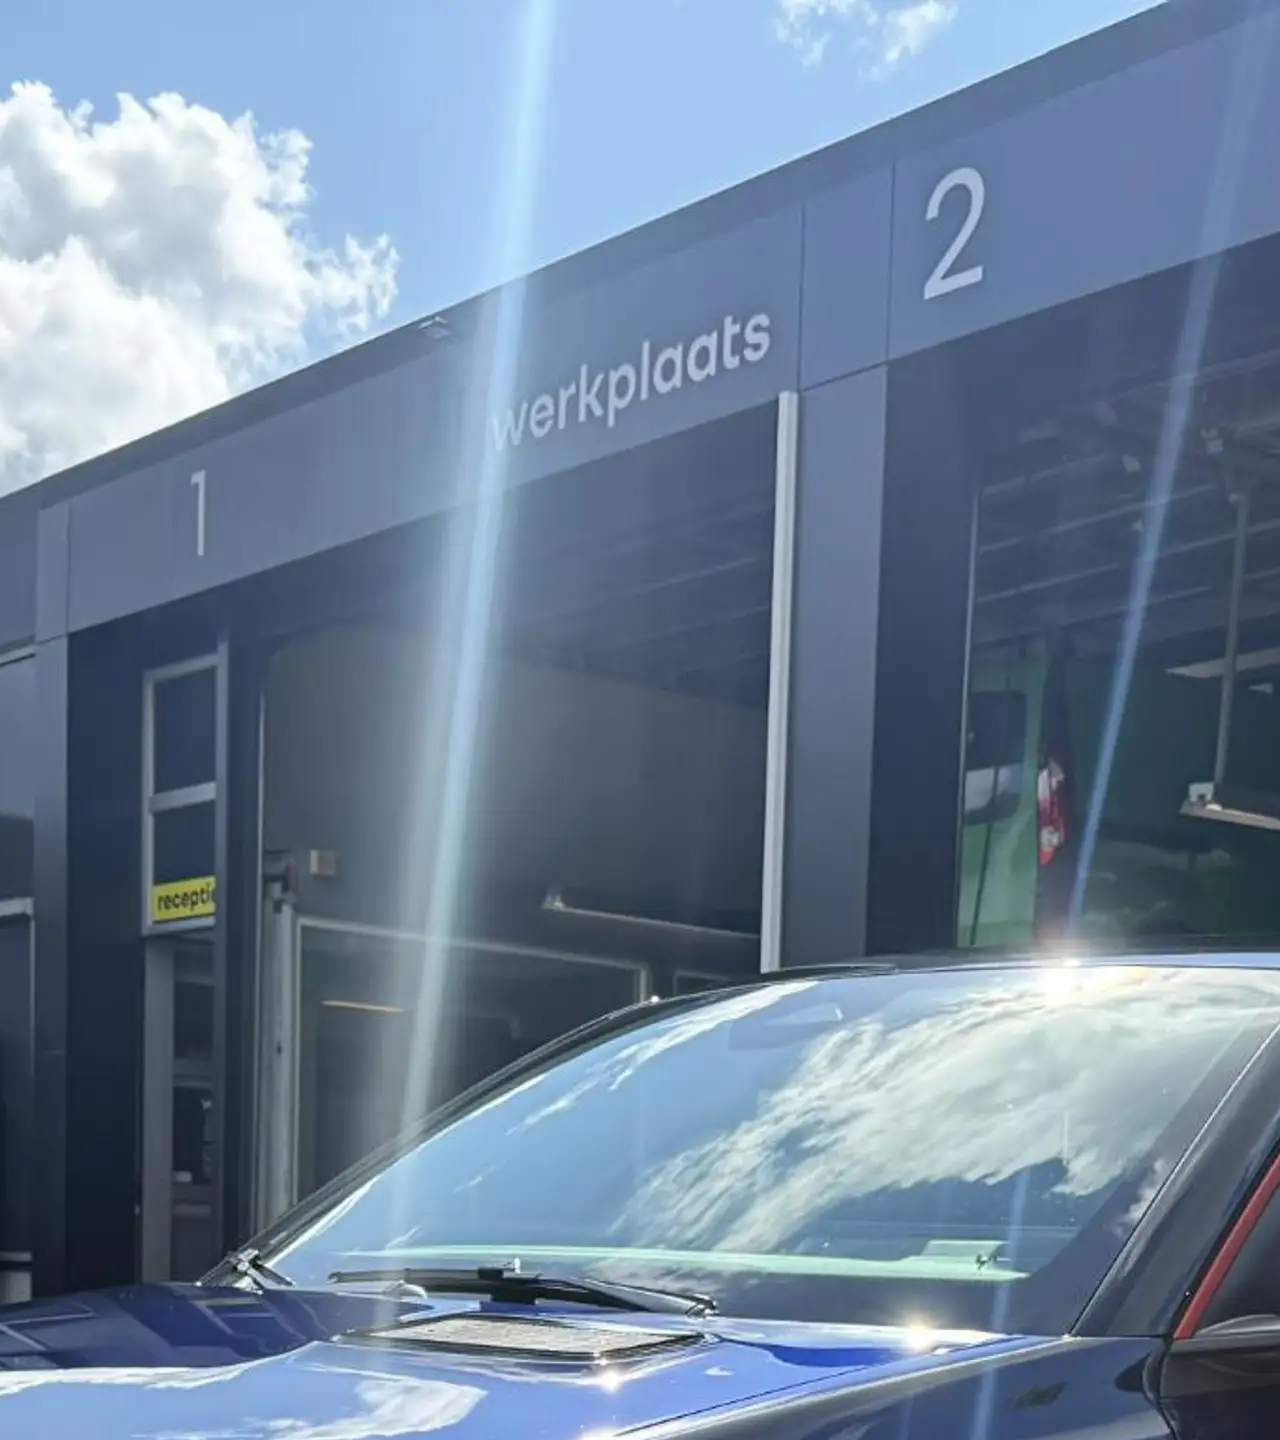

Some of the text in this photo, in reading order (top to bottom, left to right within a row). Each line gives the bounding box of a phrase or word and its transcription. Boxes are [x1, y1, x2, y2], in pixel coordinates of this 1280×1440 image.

[924, 167, 985, 300] 2
[491, 313, 770, 450] werkplaats
[190, 468, 207, 556] 1
[157, 881, 217, 912] recepti
